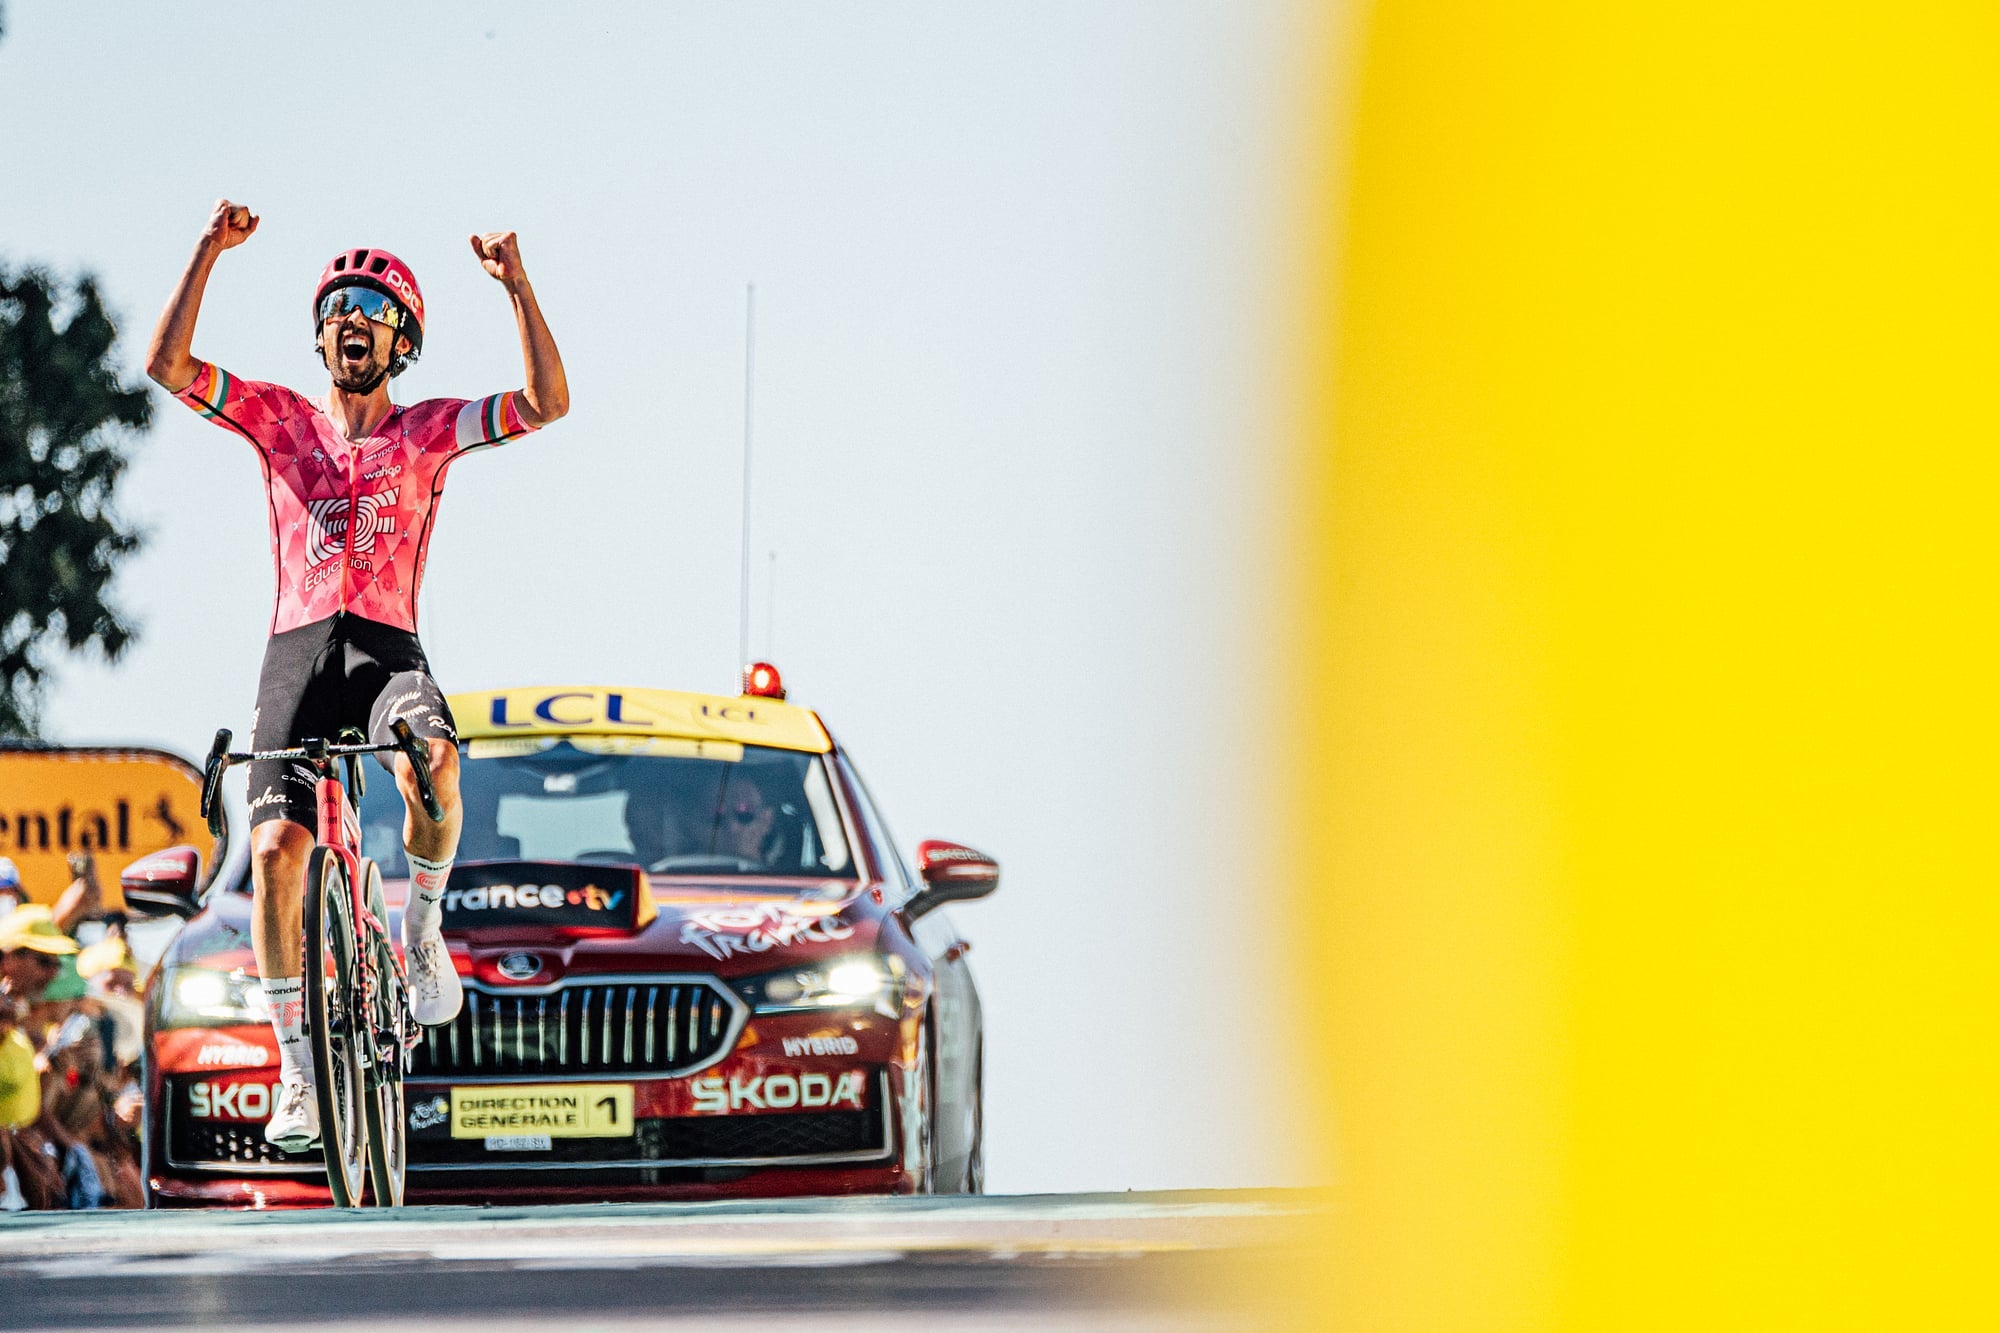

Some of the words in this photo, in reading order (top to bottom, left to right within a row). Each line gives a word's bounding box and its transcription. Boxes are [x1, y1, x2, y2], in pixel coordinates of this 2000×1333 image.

[305, 555, 371, 592] Educion
[490, 693, 653, 726] LCL
[701, 704, 768, 722] LCL
[197, 1044, 269, 1067] HYBRID
[780, 1037, 859, 1057] HYBRID
[460, 1097, 577, 1111] DIRECTION
[596, 1096, 617, 1125] 1
